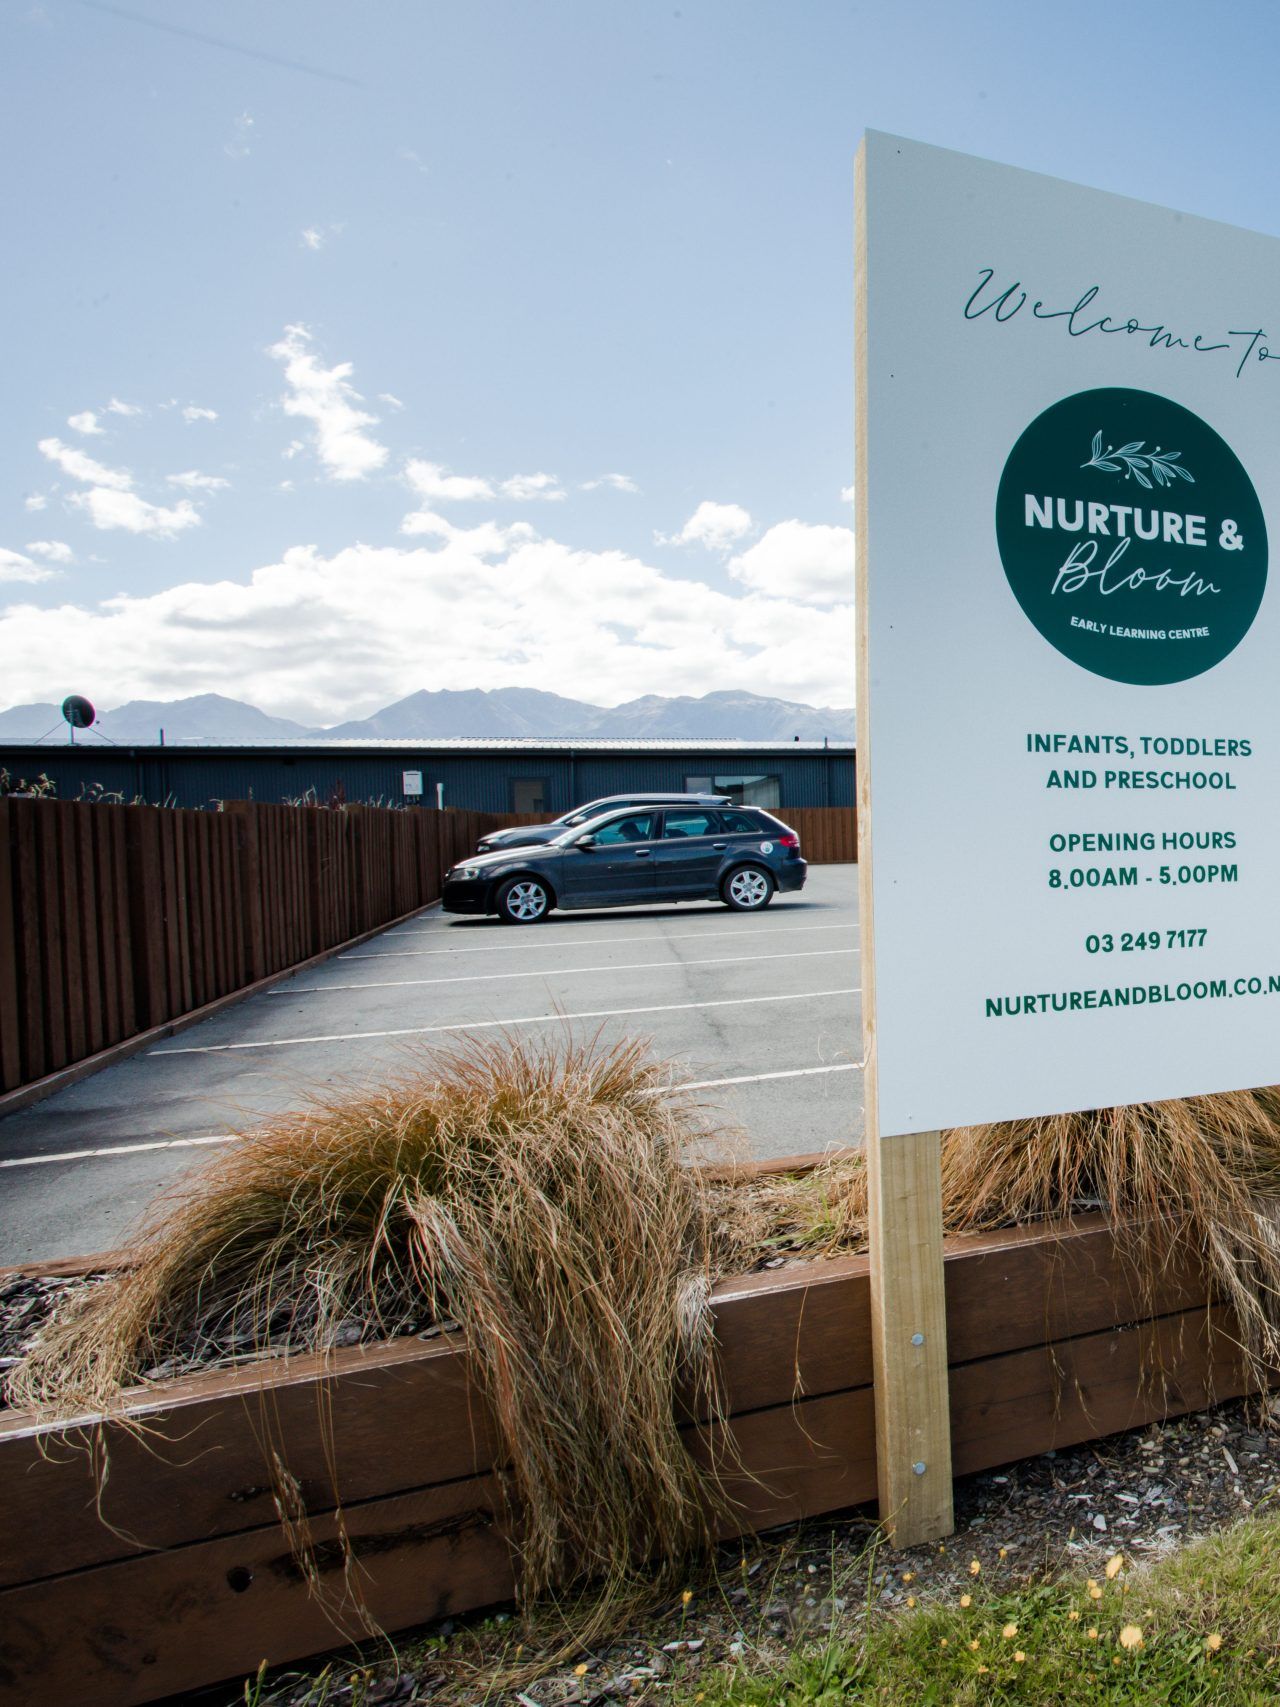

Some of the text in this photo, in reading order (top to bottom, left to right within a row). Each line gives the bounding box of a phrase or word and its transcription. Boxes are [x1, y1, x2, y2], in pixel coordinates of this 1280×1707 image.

[963, 268, 1230, 351] Welcome
[1024, 493, 1245, 551] NURTURE &
[1051, 537, 1221, 596] Bloom
[1070, 615, 1210, 640] EARLY LEARNING CENTRE
[1026, 733, 1253, 760] INFANTS, TODDLERS
[1046, 769, 1237, 790] AND PRESCHOOL
[1049, 831, 1237, 853] OPENING HOURS
[1048, 866, 1138, 890] 8.00AM
[1159, 863, 1238, 886] 5.00PM
[1086, 928, 1208, 953] 03 249 7177
